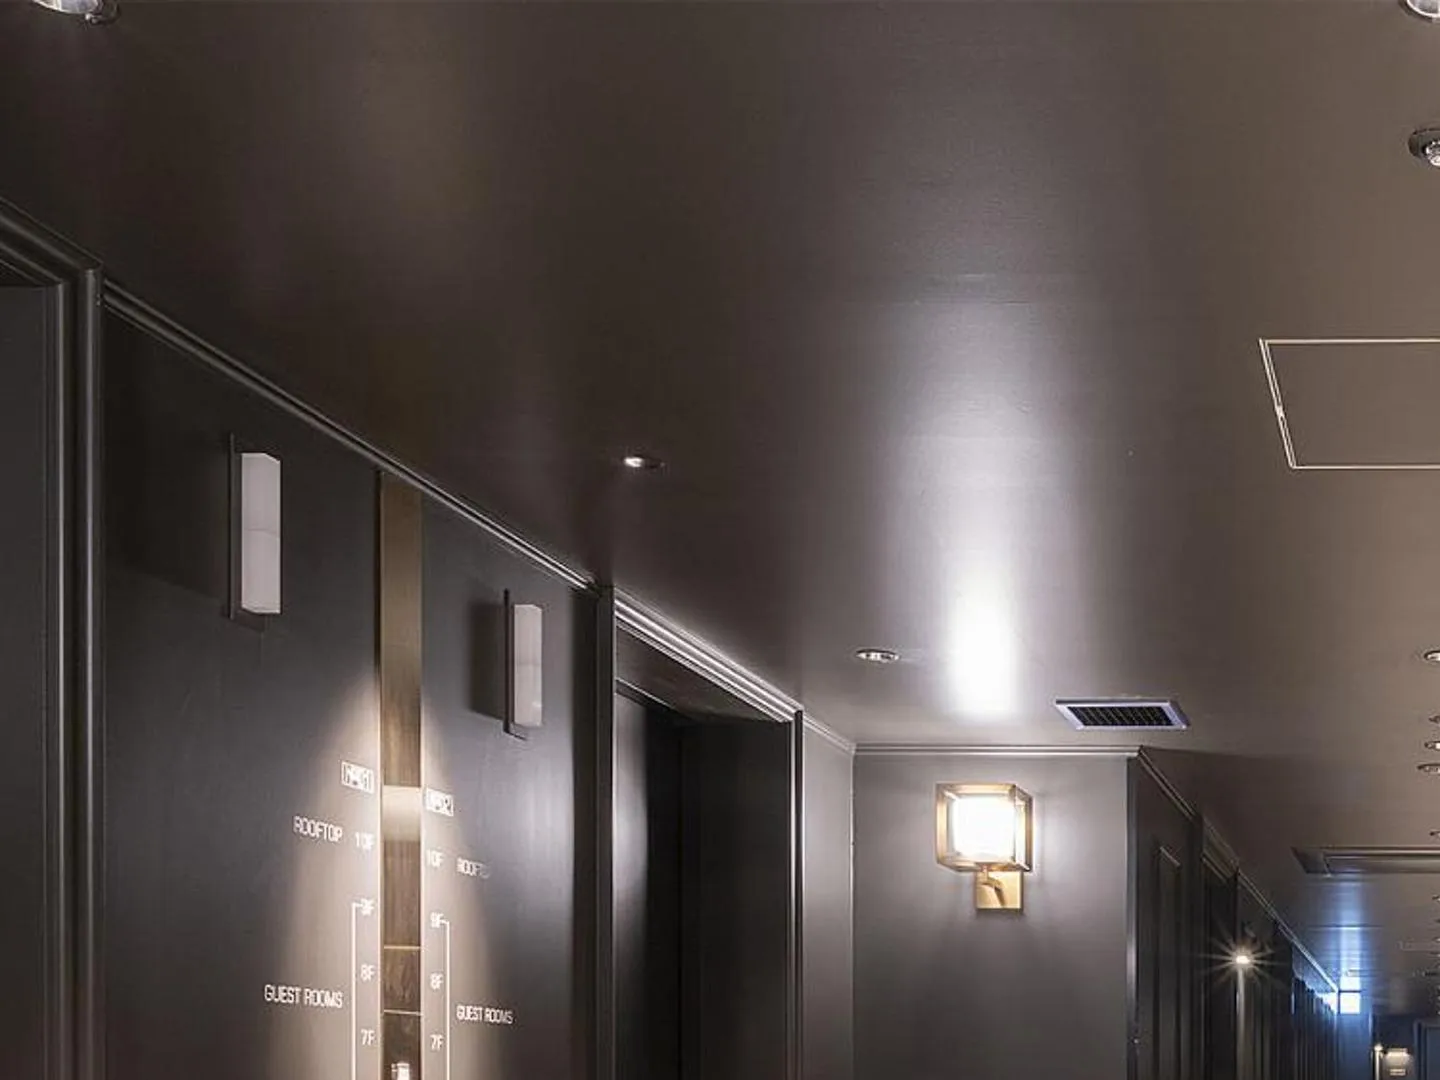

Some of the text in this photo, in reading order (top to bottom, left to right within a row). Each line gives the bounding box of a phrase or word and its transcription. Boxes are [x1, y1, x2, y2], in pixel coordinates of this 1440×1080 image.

[293, 815, 343, 843] ROOFTOP
[361, 964, 375, 982] 8F
[264, 984, 343, 1009] GUEST ROOMS
[456, 1004, 514, 1024] GUEST ROOMS
[361, 1029, 375, 1046] 7F
[430, 1034, 444, 1051] 7F
